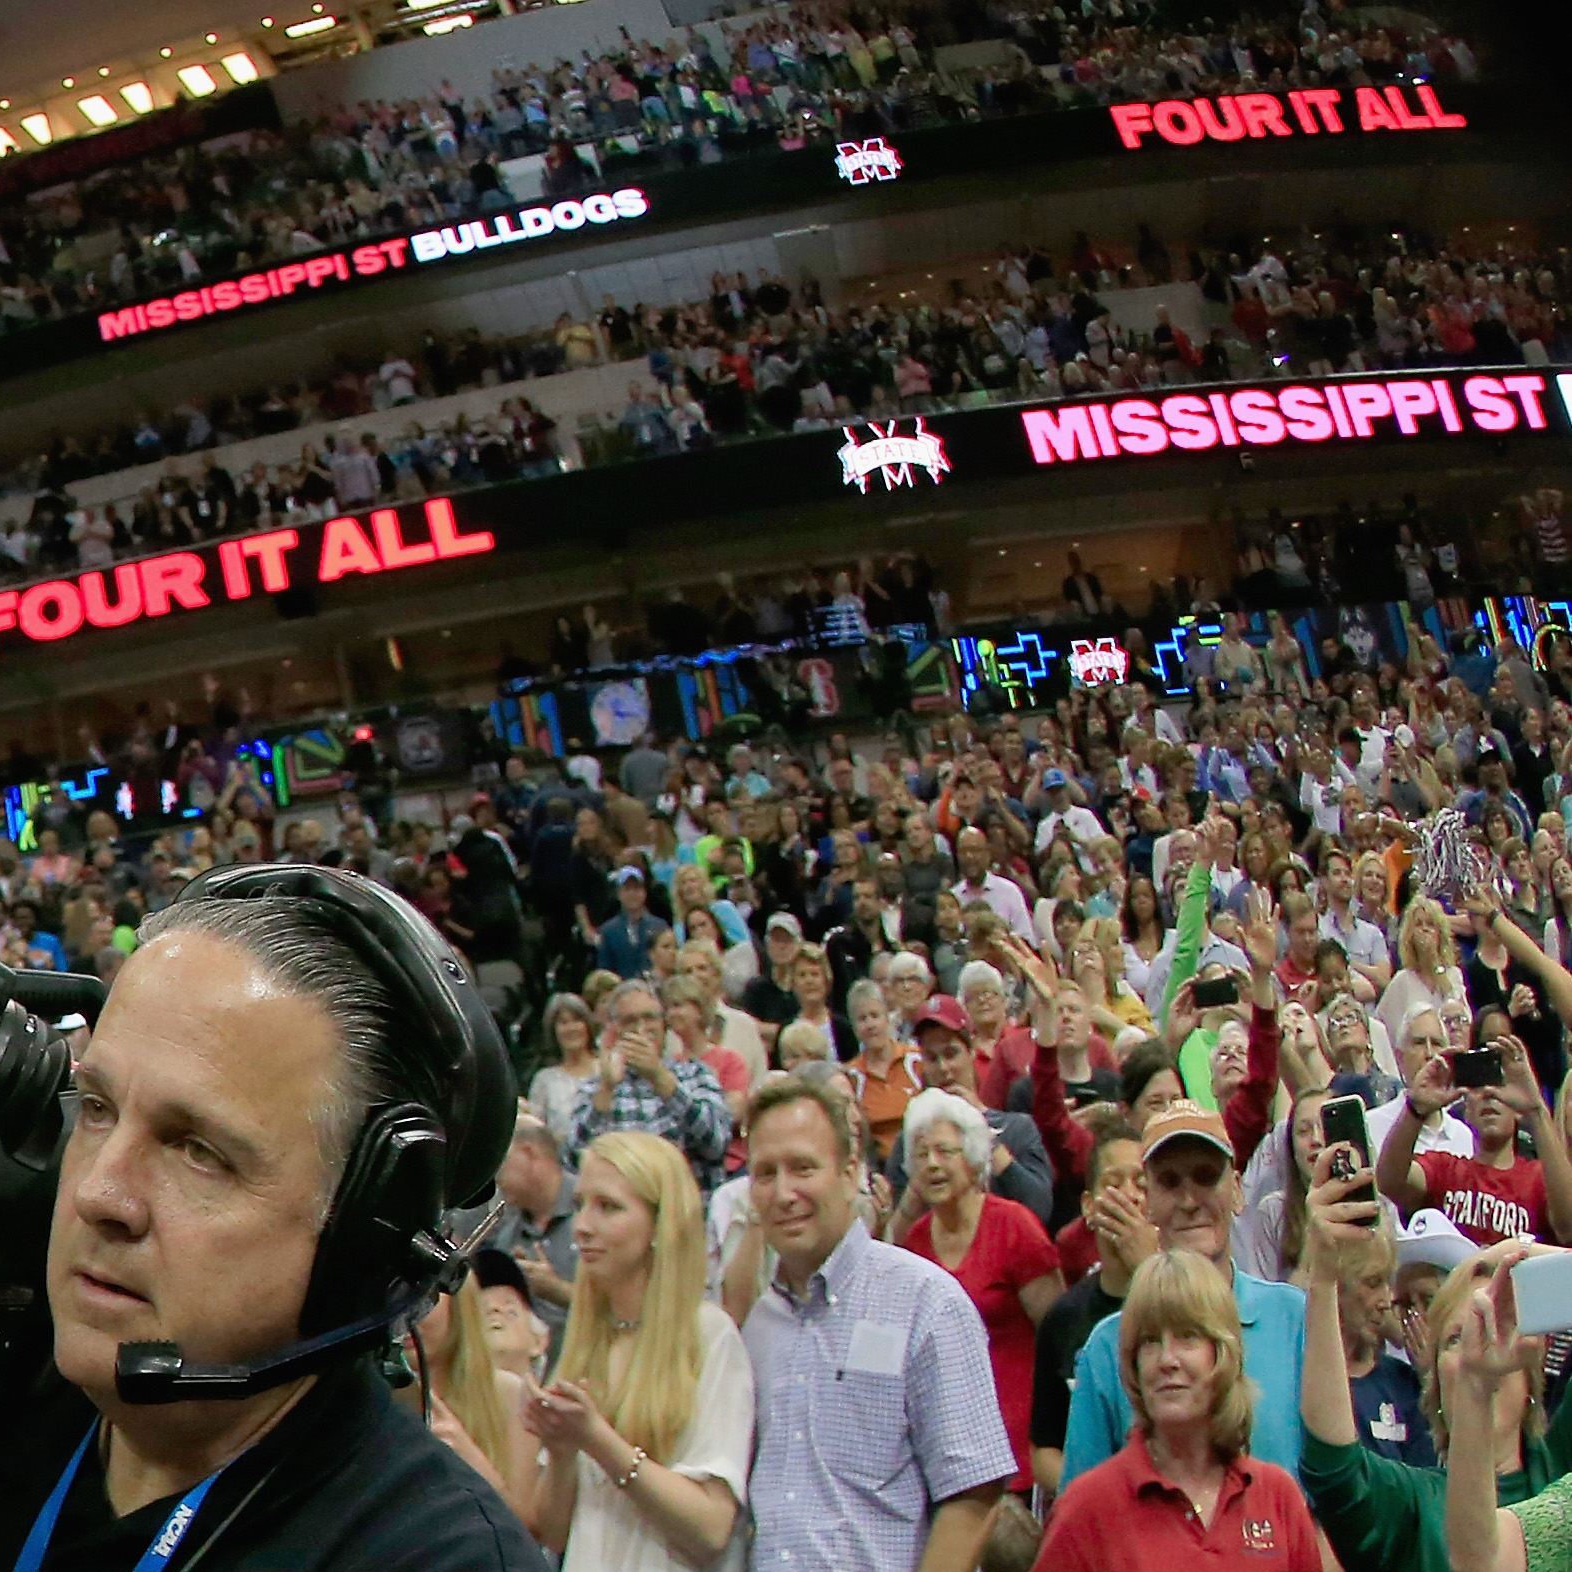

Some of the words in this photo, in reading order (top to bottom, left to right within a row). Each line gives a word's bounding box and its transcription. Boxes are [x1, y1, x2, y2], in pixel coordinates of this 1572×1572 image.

[1110, 93, 1292, 150] FOUR
[1293, 89, 1343, 135] IT
[1357, 86, 1466, 135] ALL
[98, 253, 348, 342] MISSISSIPPI
[351, 237, 408, 277] ST
[410, 187, 650, 263] BULLDOGS
[1022, 378, 1453, 466] MISSISSIPPI
[1471, 376, 1547, 431] ST
[217, 529, 297, 599] IT
[317, 498, 494, 581] ALL
[152, 1504, 193, 1557] NCAA
